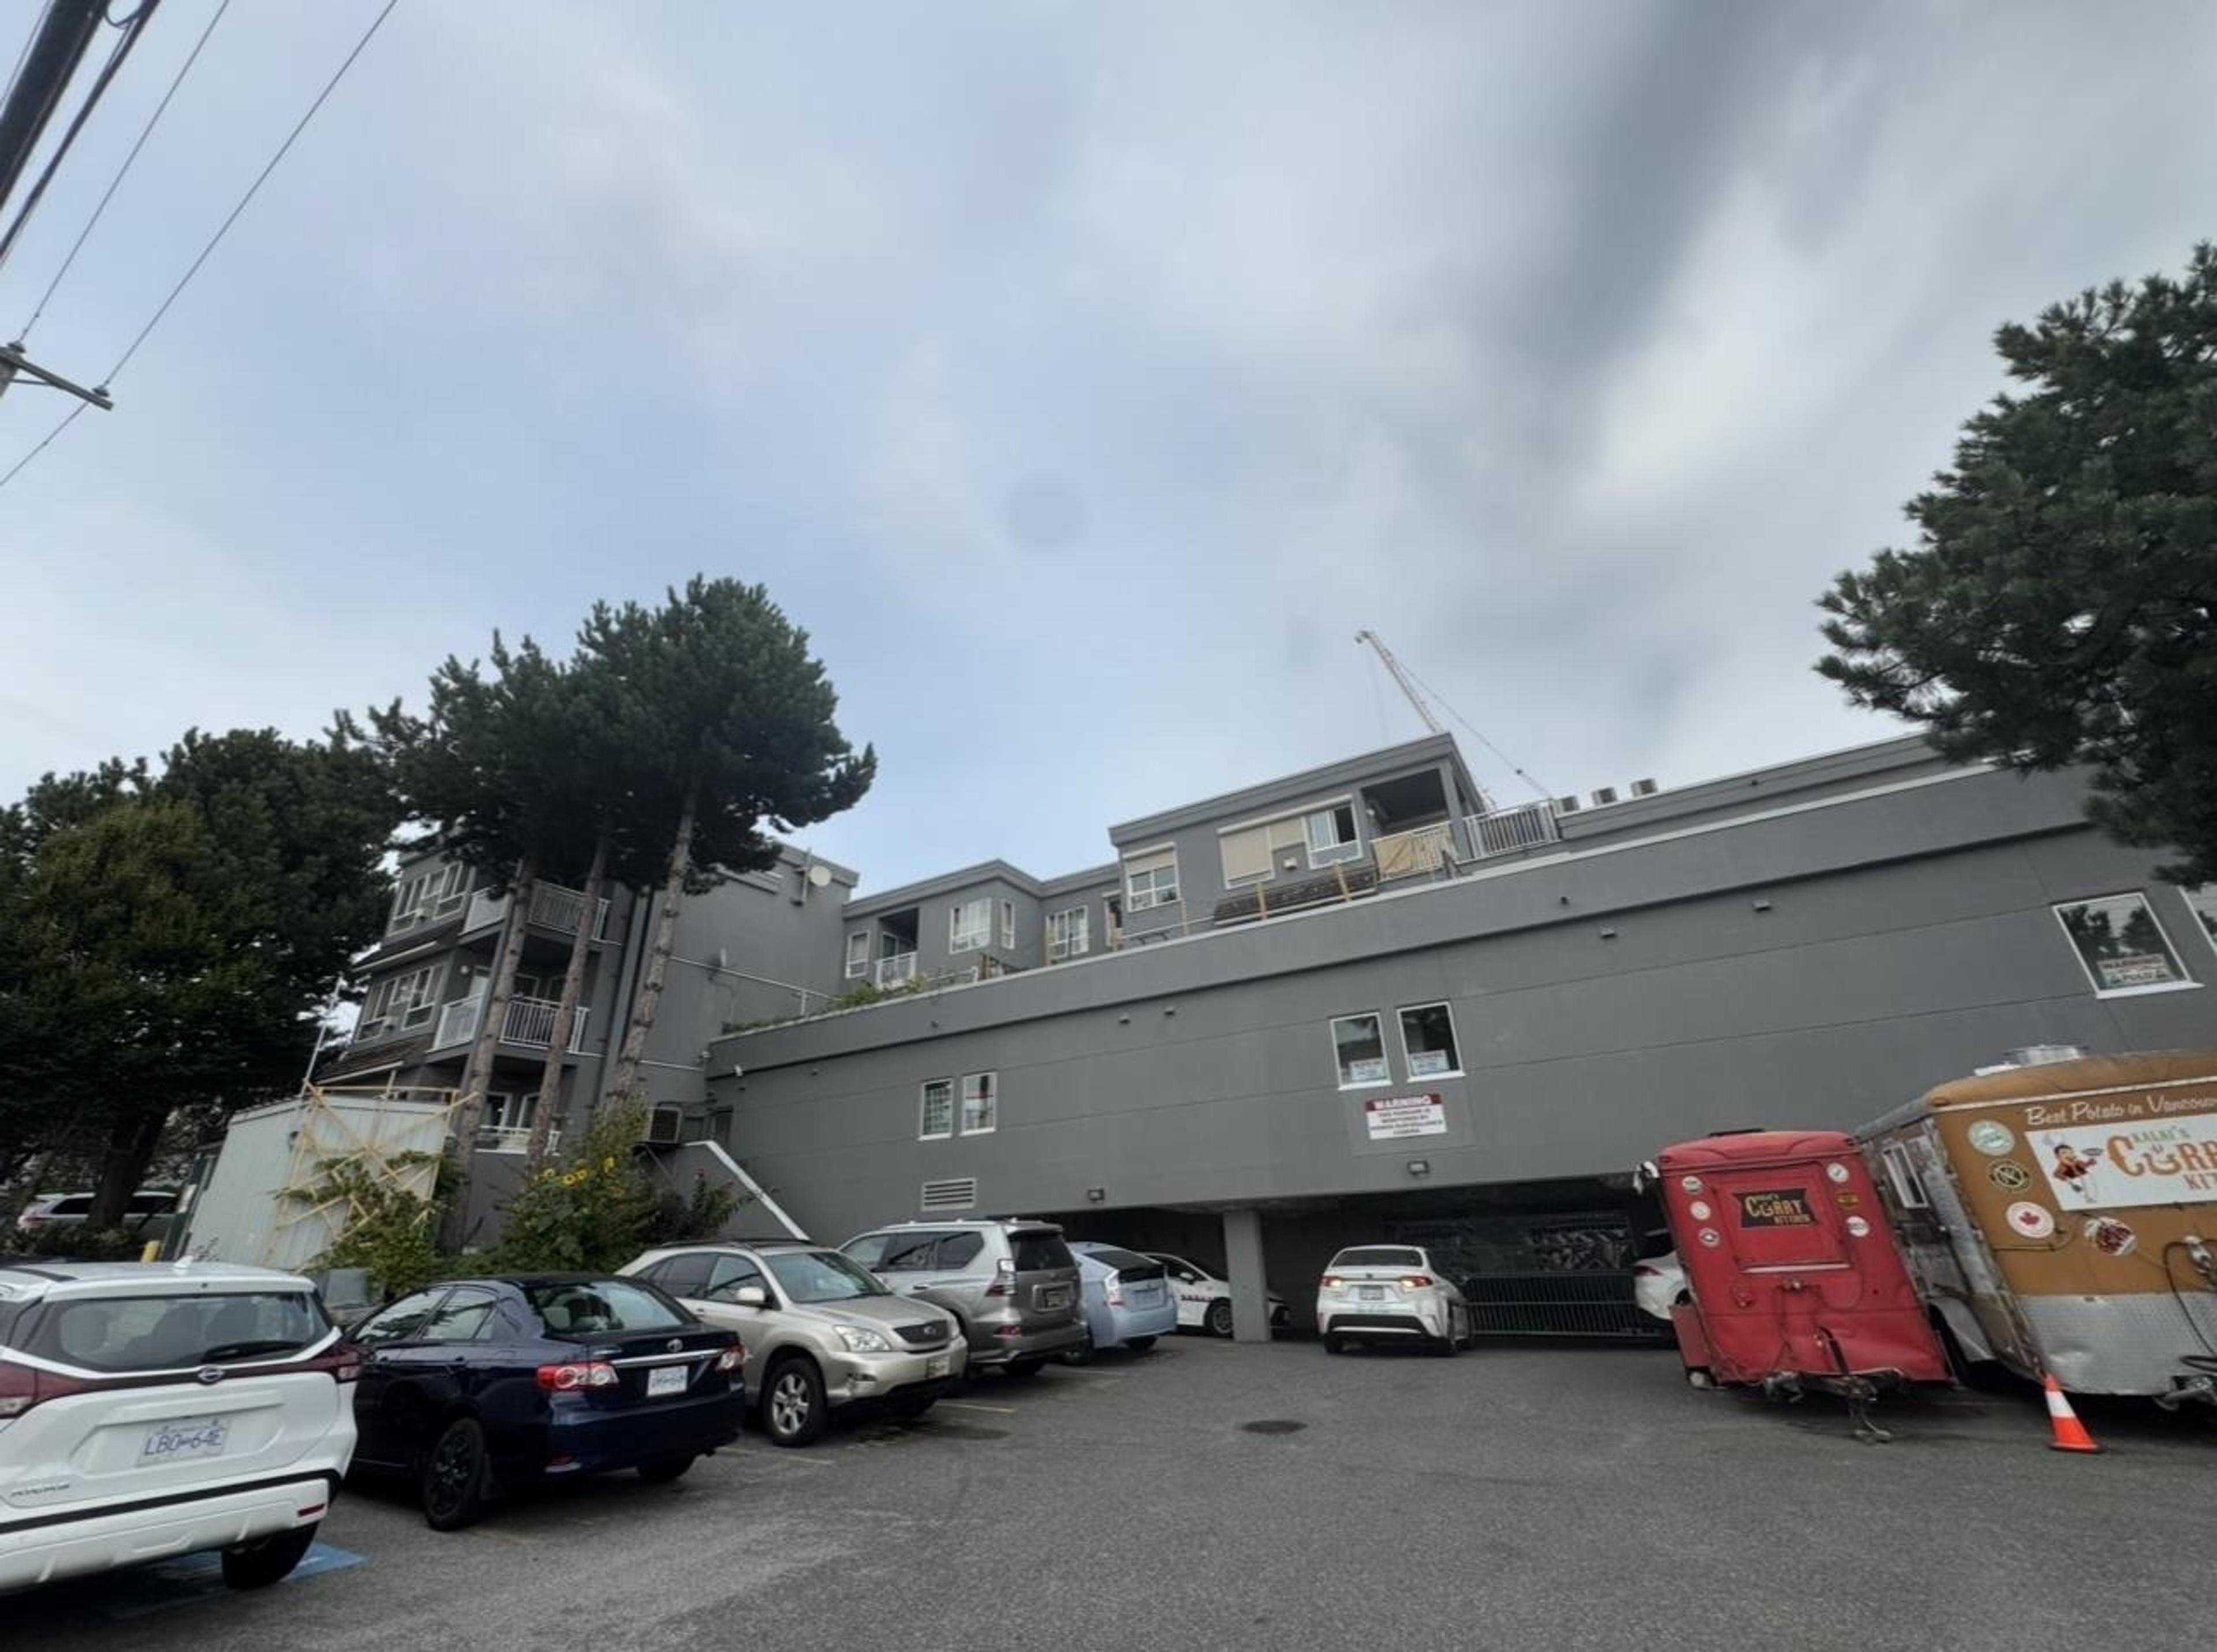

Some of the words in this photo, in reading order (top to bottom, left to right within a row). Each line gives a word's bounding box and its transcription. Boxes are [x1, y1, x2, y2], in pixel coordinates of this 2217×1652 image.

[1374, 1095, 1432, 1110] WARNING
[2025, 1105, 2067, 1125] Best
[2071, 1101, 2125, 1121] Potato
[2128, 1102, 2144, 1115] in
